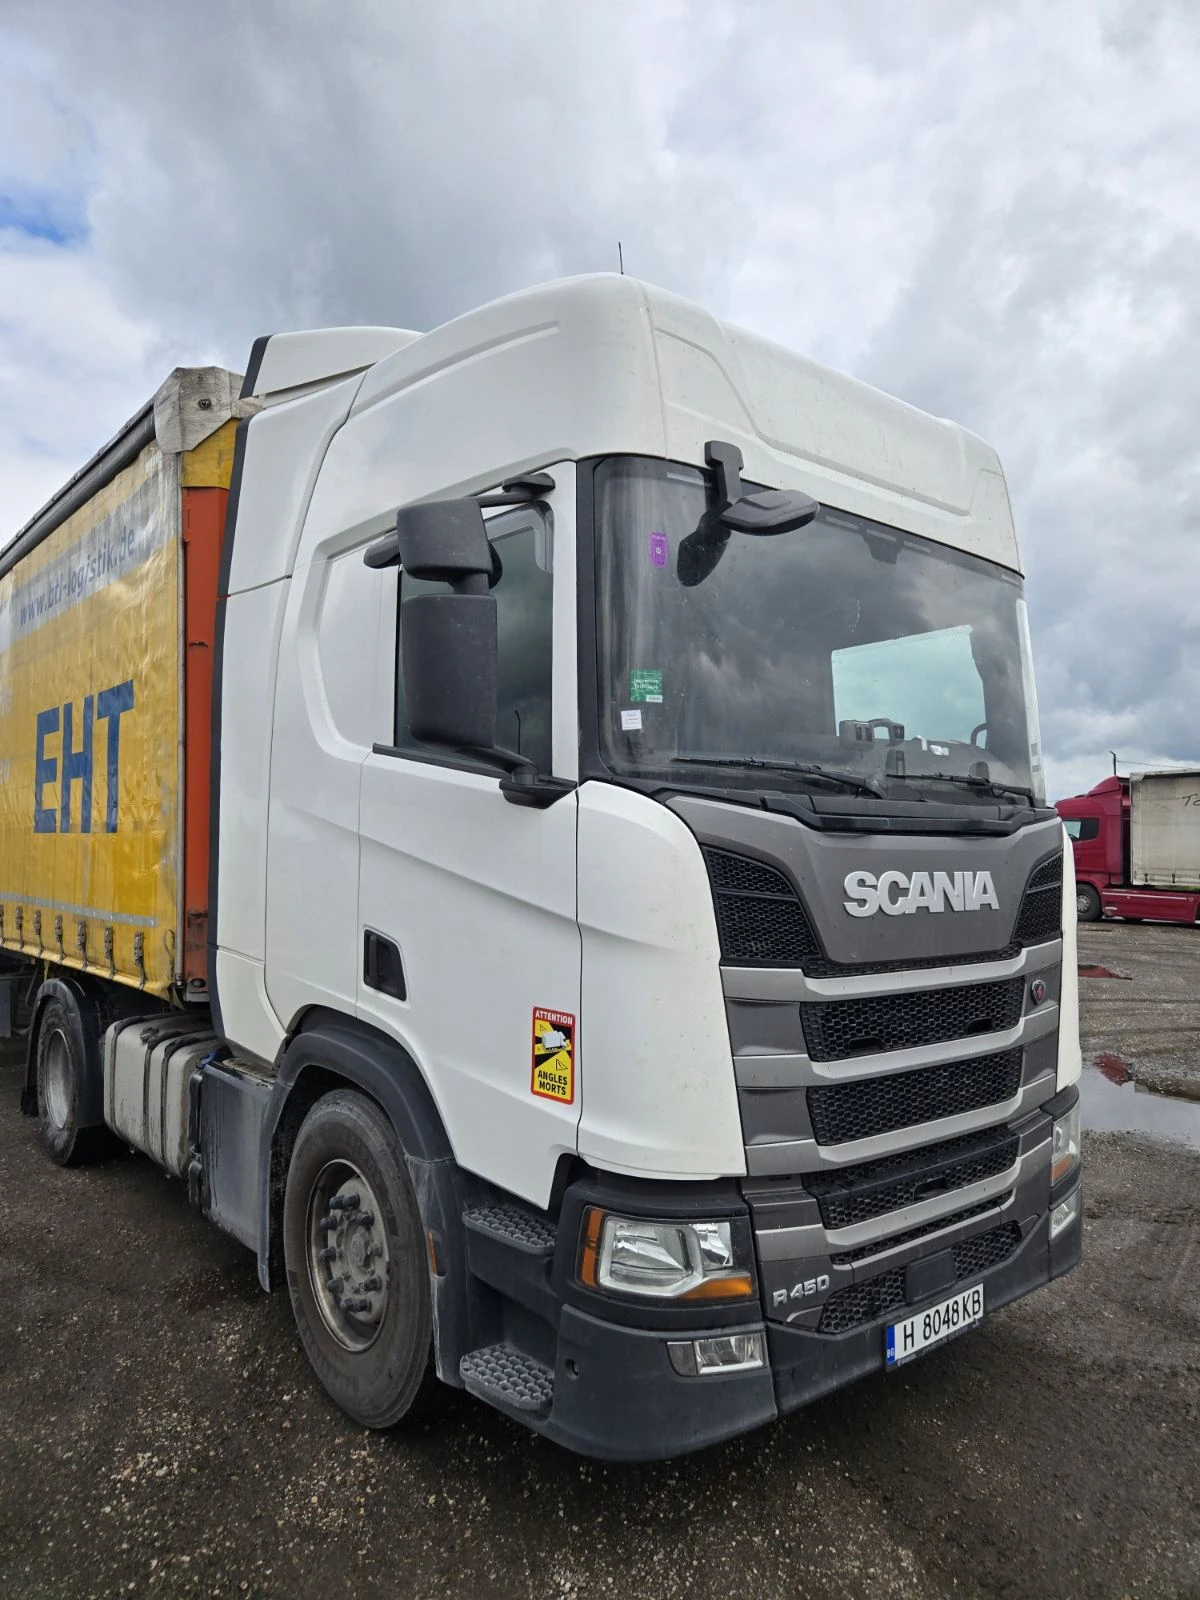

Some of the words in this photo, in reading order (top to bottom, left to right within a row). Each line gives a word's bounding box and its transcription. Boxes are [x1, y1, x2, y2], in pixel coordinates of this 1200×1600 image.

[34, 679, 135, 834] EHT
[843, 870, 1000, 918] SCANIA
[535, 1010, 573, 1025] ATTENTION
[537, 1070, 568, 1086] ANGLES
[538, 1081, 567, 1096] MORTS
[772, 1288, 788, 1308] R
[790, 1274, 830, 1300] 450
[903, 1320, 915, 1352] H
[922, 1300, 960, 1341] 8048
[962, 1289, 981, 1321] KB
